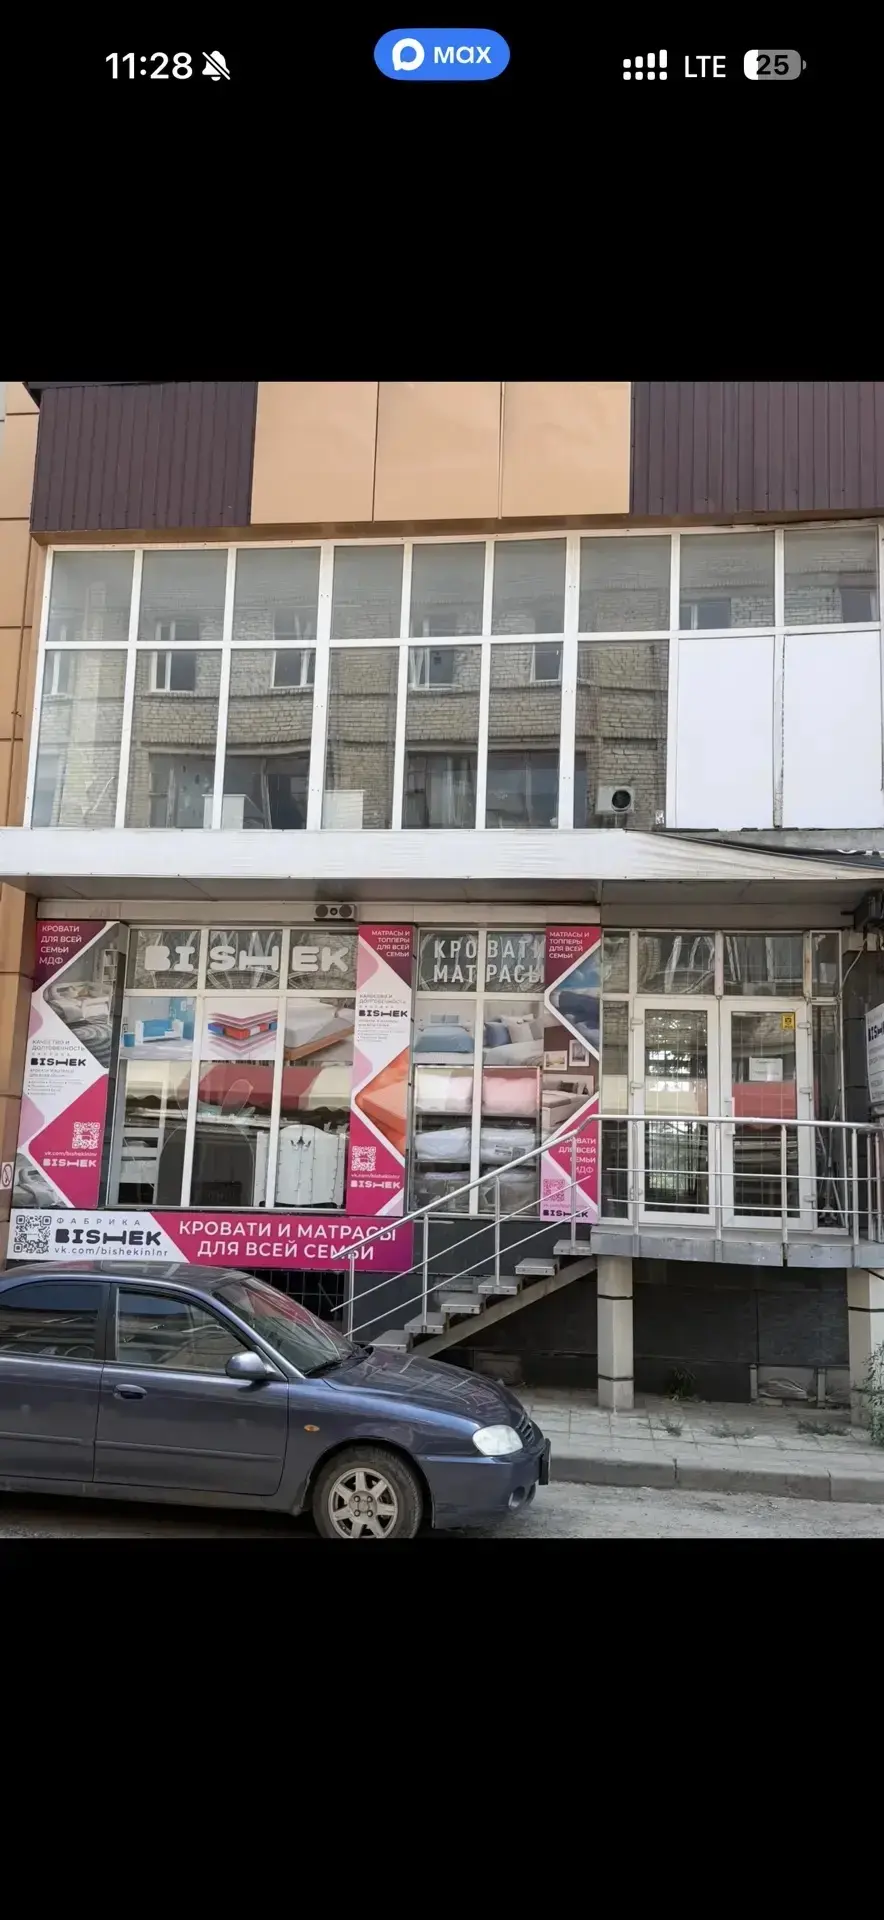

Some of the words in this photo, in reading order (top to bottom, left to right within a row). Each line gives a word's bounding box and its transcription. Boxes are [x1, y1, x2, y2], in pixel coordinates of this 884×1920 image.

[42, 925, 80, 933] КРОВАТИ
[60, 935, 82, 943] ВСЕЙ
[40, 946, 69, 954] СЕМЬИ
[433, 940, 545, 959] КРОВАТИ
[39, 957, 64, 965] МДФ
[144, 945, 349, 972] BISHEK
[433, 964, 545, 983] МАТРАСЫ
[359, 1009, 408, 1018] BISHEK
[31, 1057, 87, 1067] BISHEK
[43, 1158, 97, 1167] BISHEK
[350, 1180, 400, 1189] BISHEK
[57, 1218, 141, 1226] ФАБРИКА
[179, 1220, 271, 1238] КРОВАТИ
[278, 1223, 291, 1238] И
[297, 1223, 396, 1242] МАТРАСЫ
[55, 1229, 162, 1246] BISHEK
[54, 1246, 168, 1257] vk.com/bishekinlnr
[197, 1241, 239, 1257] ДЛЯ
[245, 1240, 298, 1258] ВСЕЙ
[303, 1243, 375, 1260] СЕМЬИ
